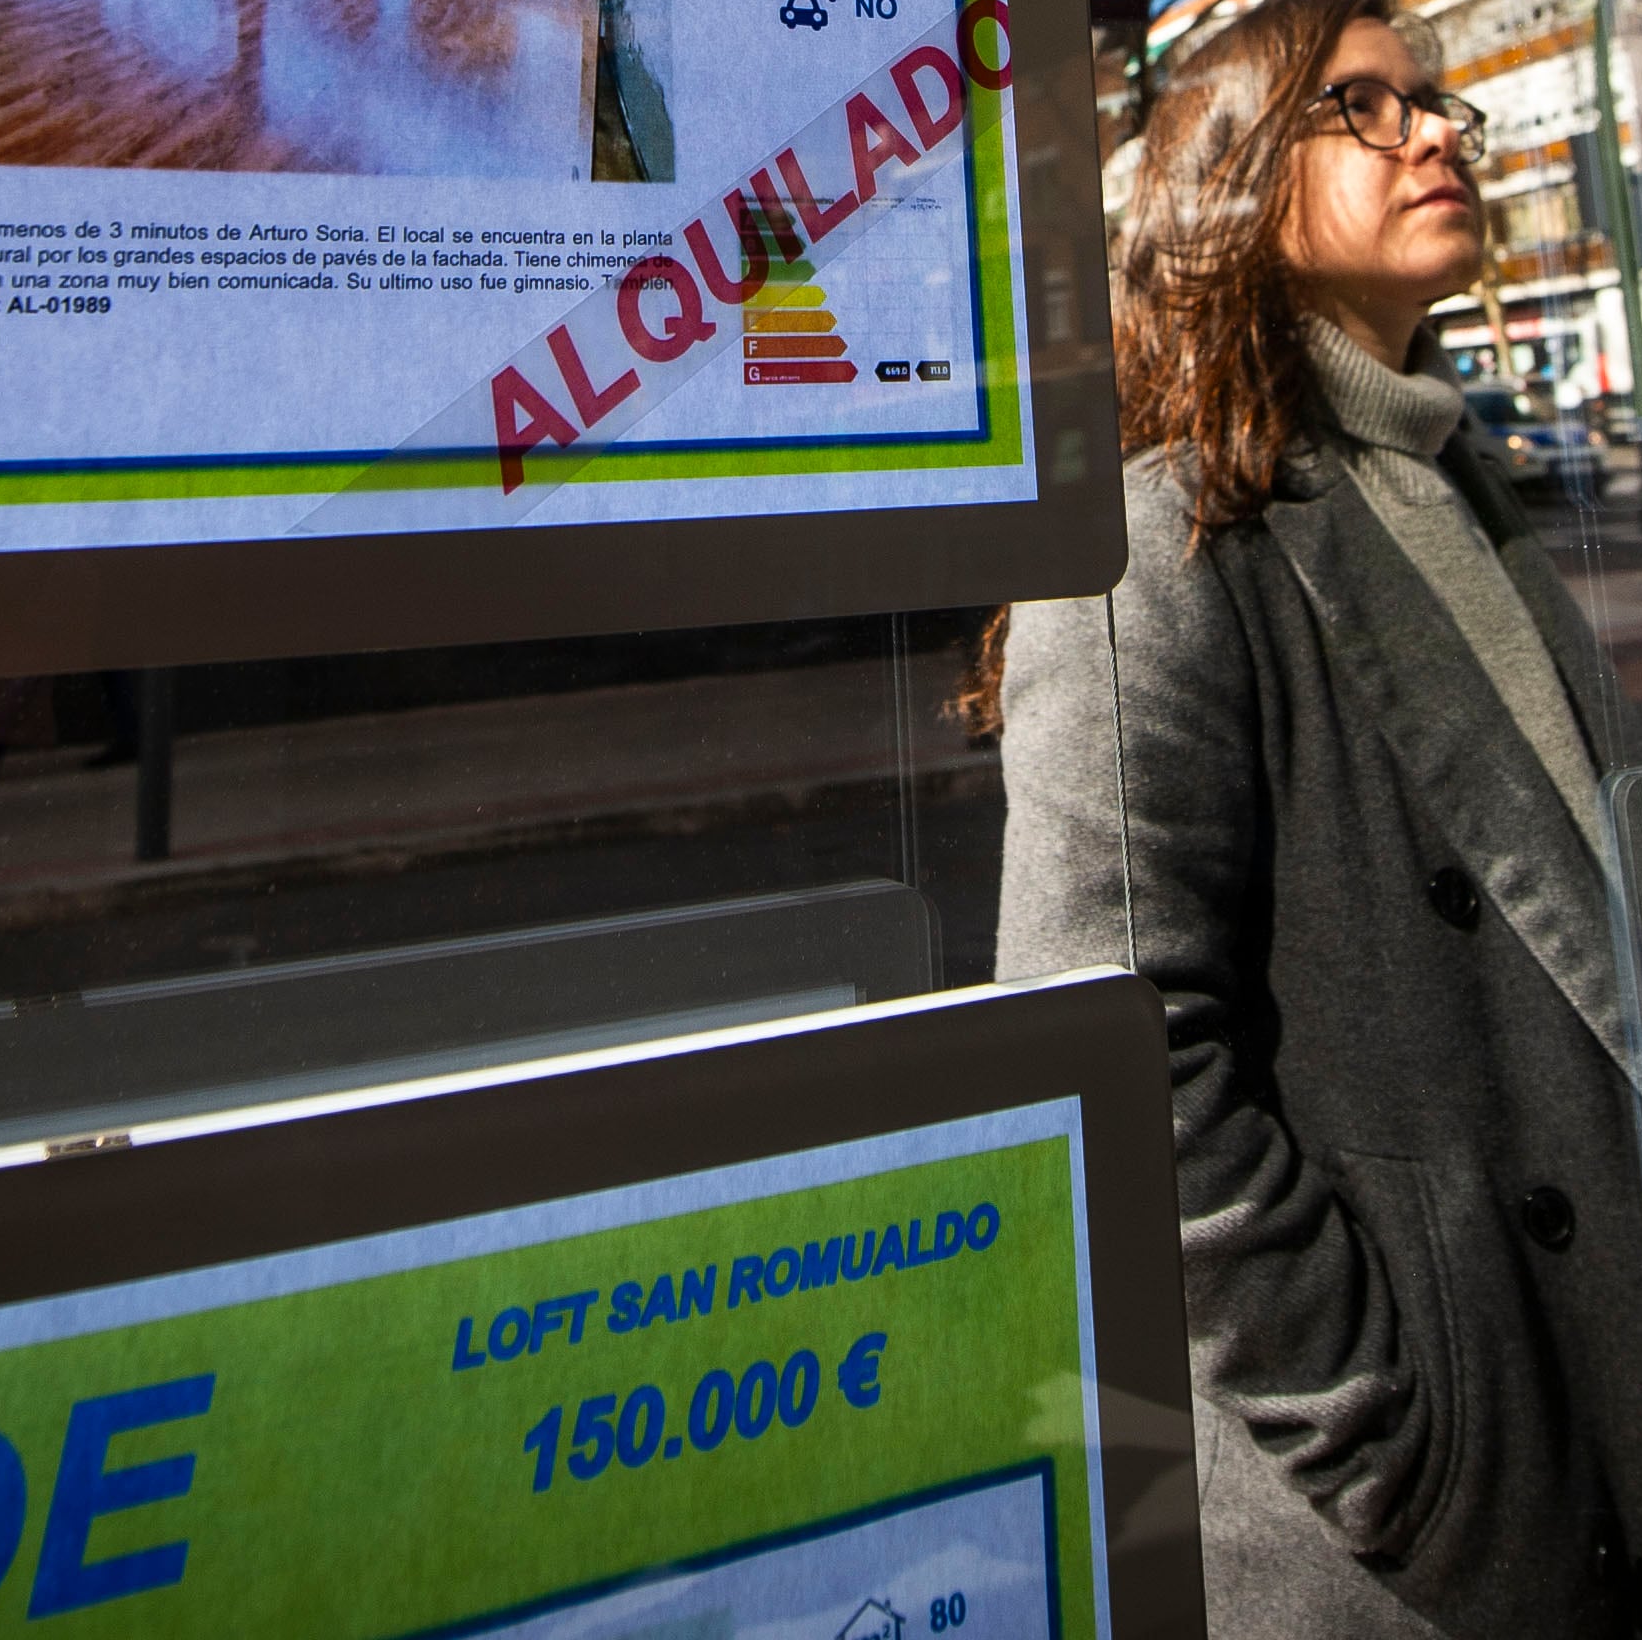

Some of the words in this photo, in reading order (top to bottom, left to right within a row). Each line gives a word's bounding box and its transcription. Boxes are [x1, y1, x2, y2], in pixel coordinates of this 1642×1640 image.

[74, 220, 101, 239] de
[109, 221, 122, 239] 3
[131, 222, 209, 241] minutos
[216, 223, 242, 241] de
[248, 223, 308, 242] Arturo
[316, 224, 369, 243] Soria.
[378, 225, 395, 243] El
[403, 226, 444, 244] local
[452, 231, 474, 244] se
[481, 229, 565, 245] encuentra
[572, 232, 594, 245] en
[601, 229, 615, 246] la
[622, 229, 673, 249] planta
[38, 249, 73, 267] por
[77, 246, 108, 264] los
[113, 246, 195, 268] grandes
[200, 248, 287, 269] espacios
[292, 247, 317, 266] de
[322, 249, 378, 269] pavés
[382, 249, 406, 267] de
[411, 249, 427, 267] la
[432, 249, 508, 267] fachada.
[513, 250, 561, 268] Tiene
[565, 251, 647, 269] chimenea
[11, 274, 51, 289] una
[58, 274, 109, 289] zona
[117, 275, 161, 293] muy
[168, 271, 210, 289] bien
[217, 271, 339, 290] comunicada.
[347, 272, 372, 290] Su
[379, 272, 433, 290] ultimo
[440, 277, 473, 290] uso
[479, 272, 507, 290] fue
[513, 274, 594, 294] gimnasio.
[7, 295, 112, 314] AL-01989
[451, 1288, 600, 1371] LOFT
[605, 1264, 719, 1334] SAN
[726, 1201, 1001, 1305] ROMUALDO
[522, 1348, 820, 1494] 150.000
[837, 1331, 888, 1409] €
[930, 1591, 967, 1633] 80
